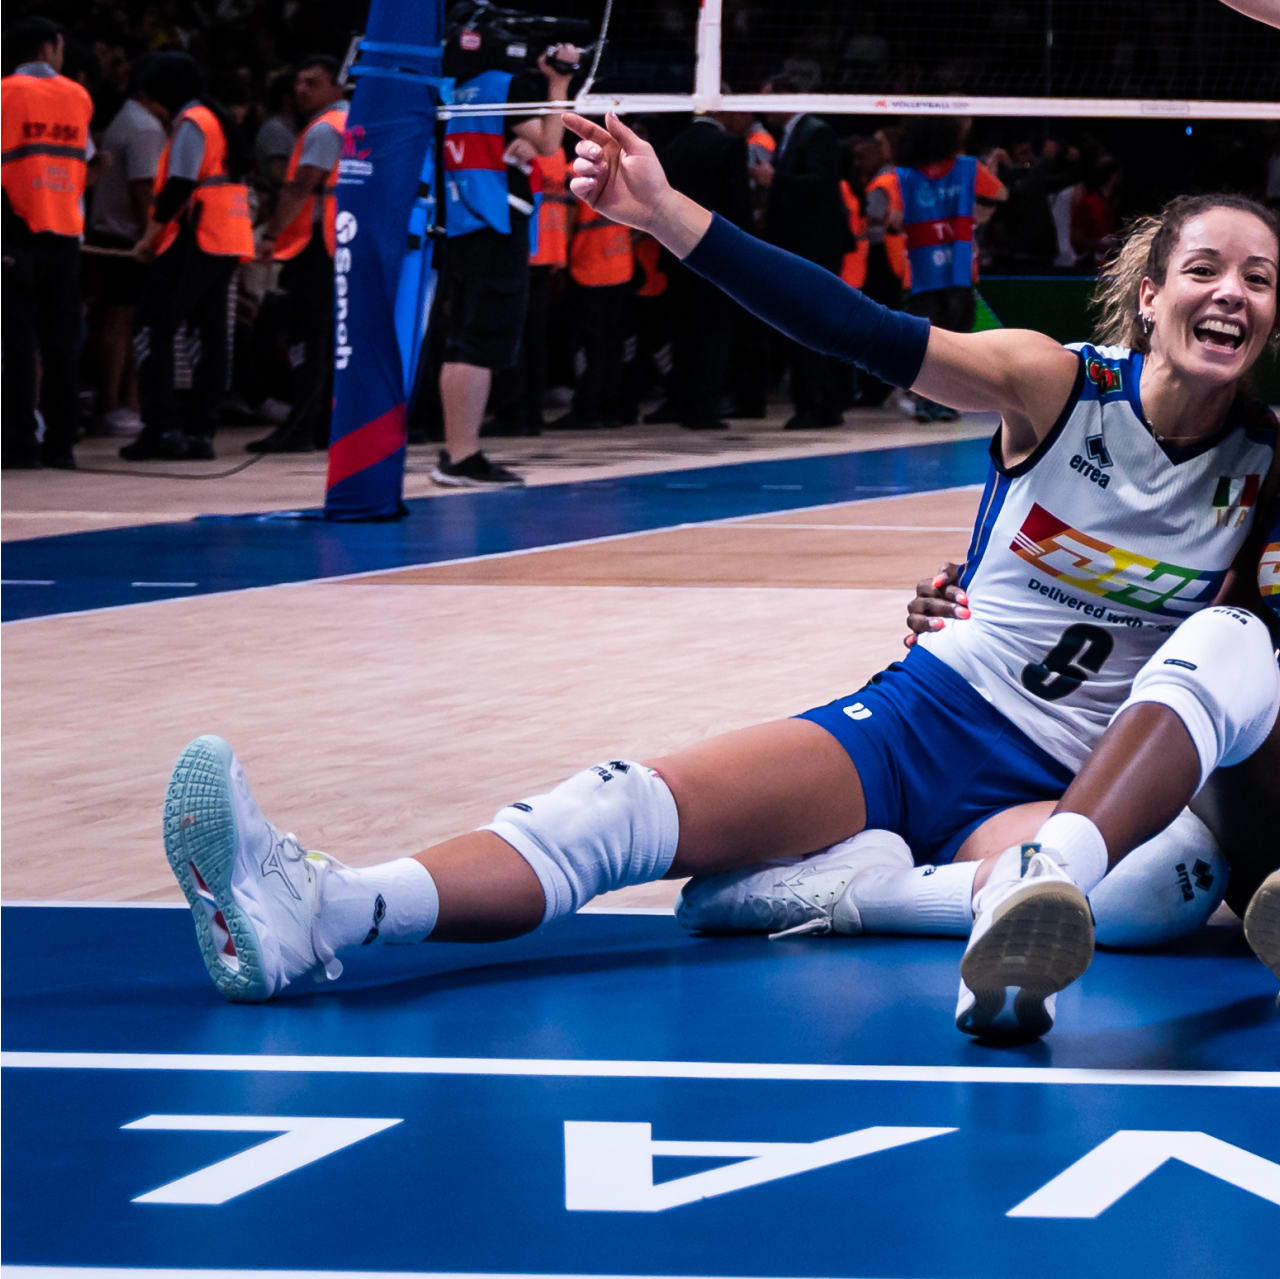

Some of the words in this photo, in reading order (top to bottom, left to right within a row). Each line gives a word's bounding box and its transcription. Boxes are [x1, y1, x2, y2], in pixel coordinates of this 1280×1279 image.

[335, 247, 352, 370] Senoh
[1028, 578, 1106, 618] Delivered
[1034, 534, 1212, 610] DHL
